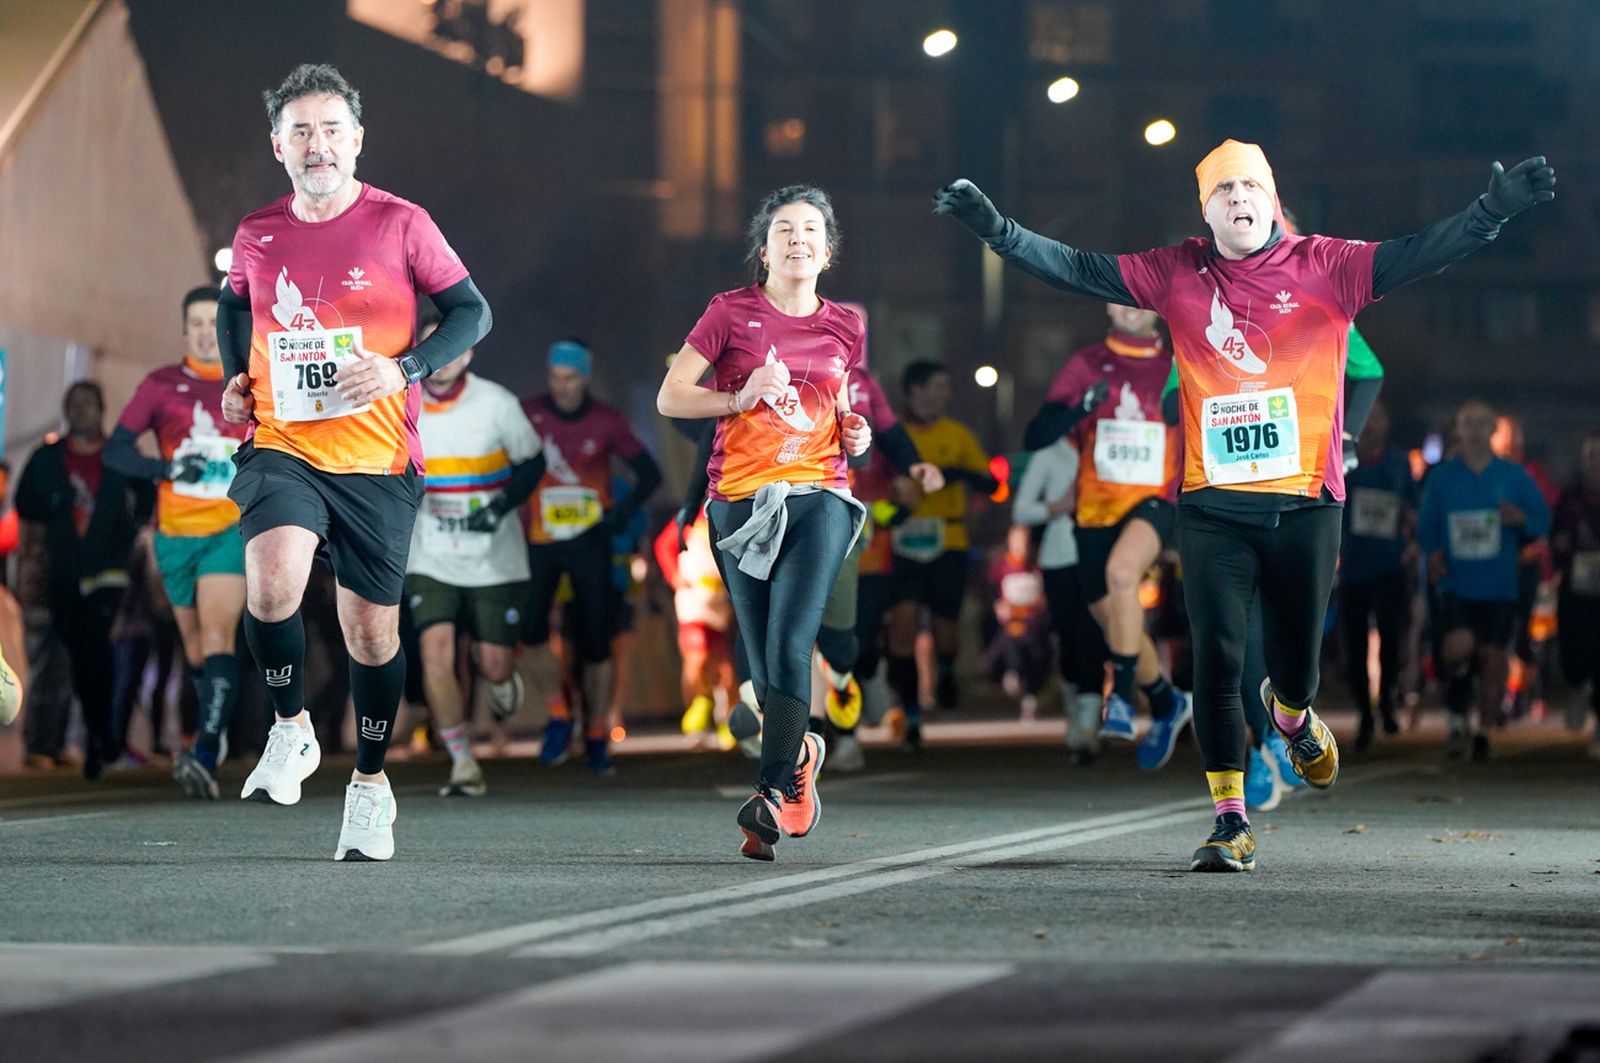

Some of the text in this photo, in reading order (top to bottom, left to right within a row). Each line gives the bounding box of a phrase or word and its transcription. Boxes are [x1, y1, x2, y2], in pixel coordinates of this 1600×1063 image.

[288, 341, 313, 350] NOCHE
[314, 340, 326, 349] DE
[1221, 336, 1245, 361] 43
[280, 353, 296, 362] SAN
[294, 362, 339, 390] 769
[774, 392, 799, 417] 43
[1220, 404, 1247, 414] NOCHE
[1248, 402, 1260, 412] DE
[1211, 416, 1229, 427] SAN
[1221, 422, 1279, 453] 1976
